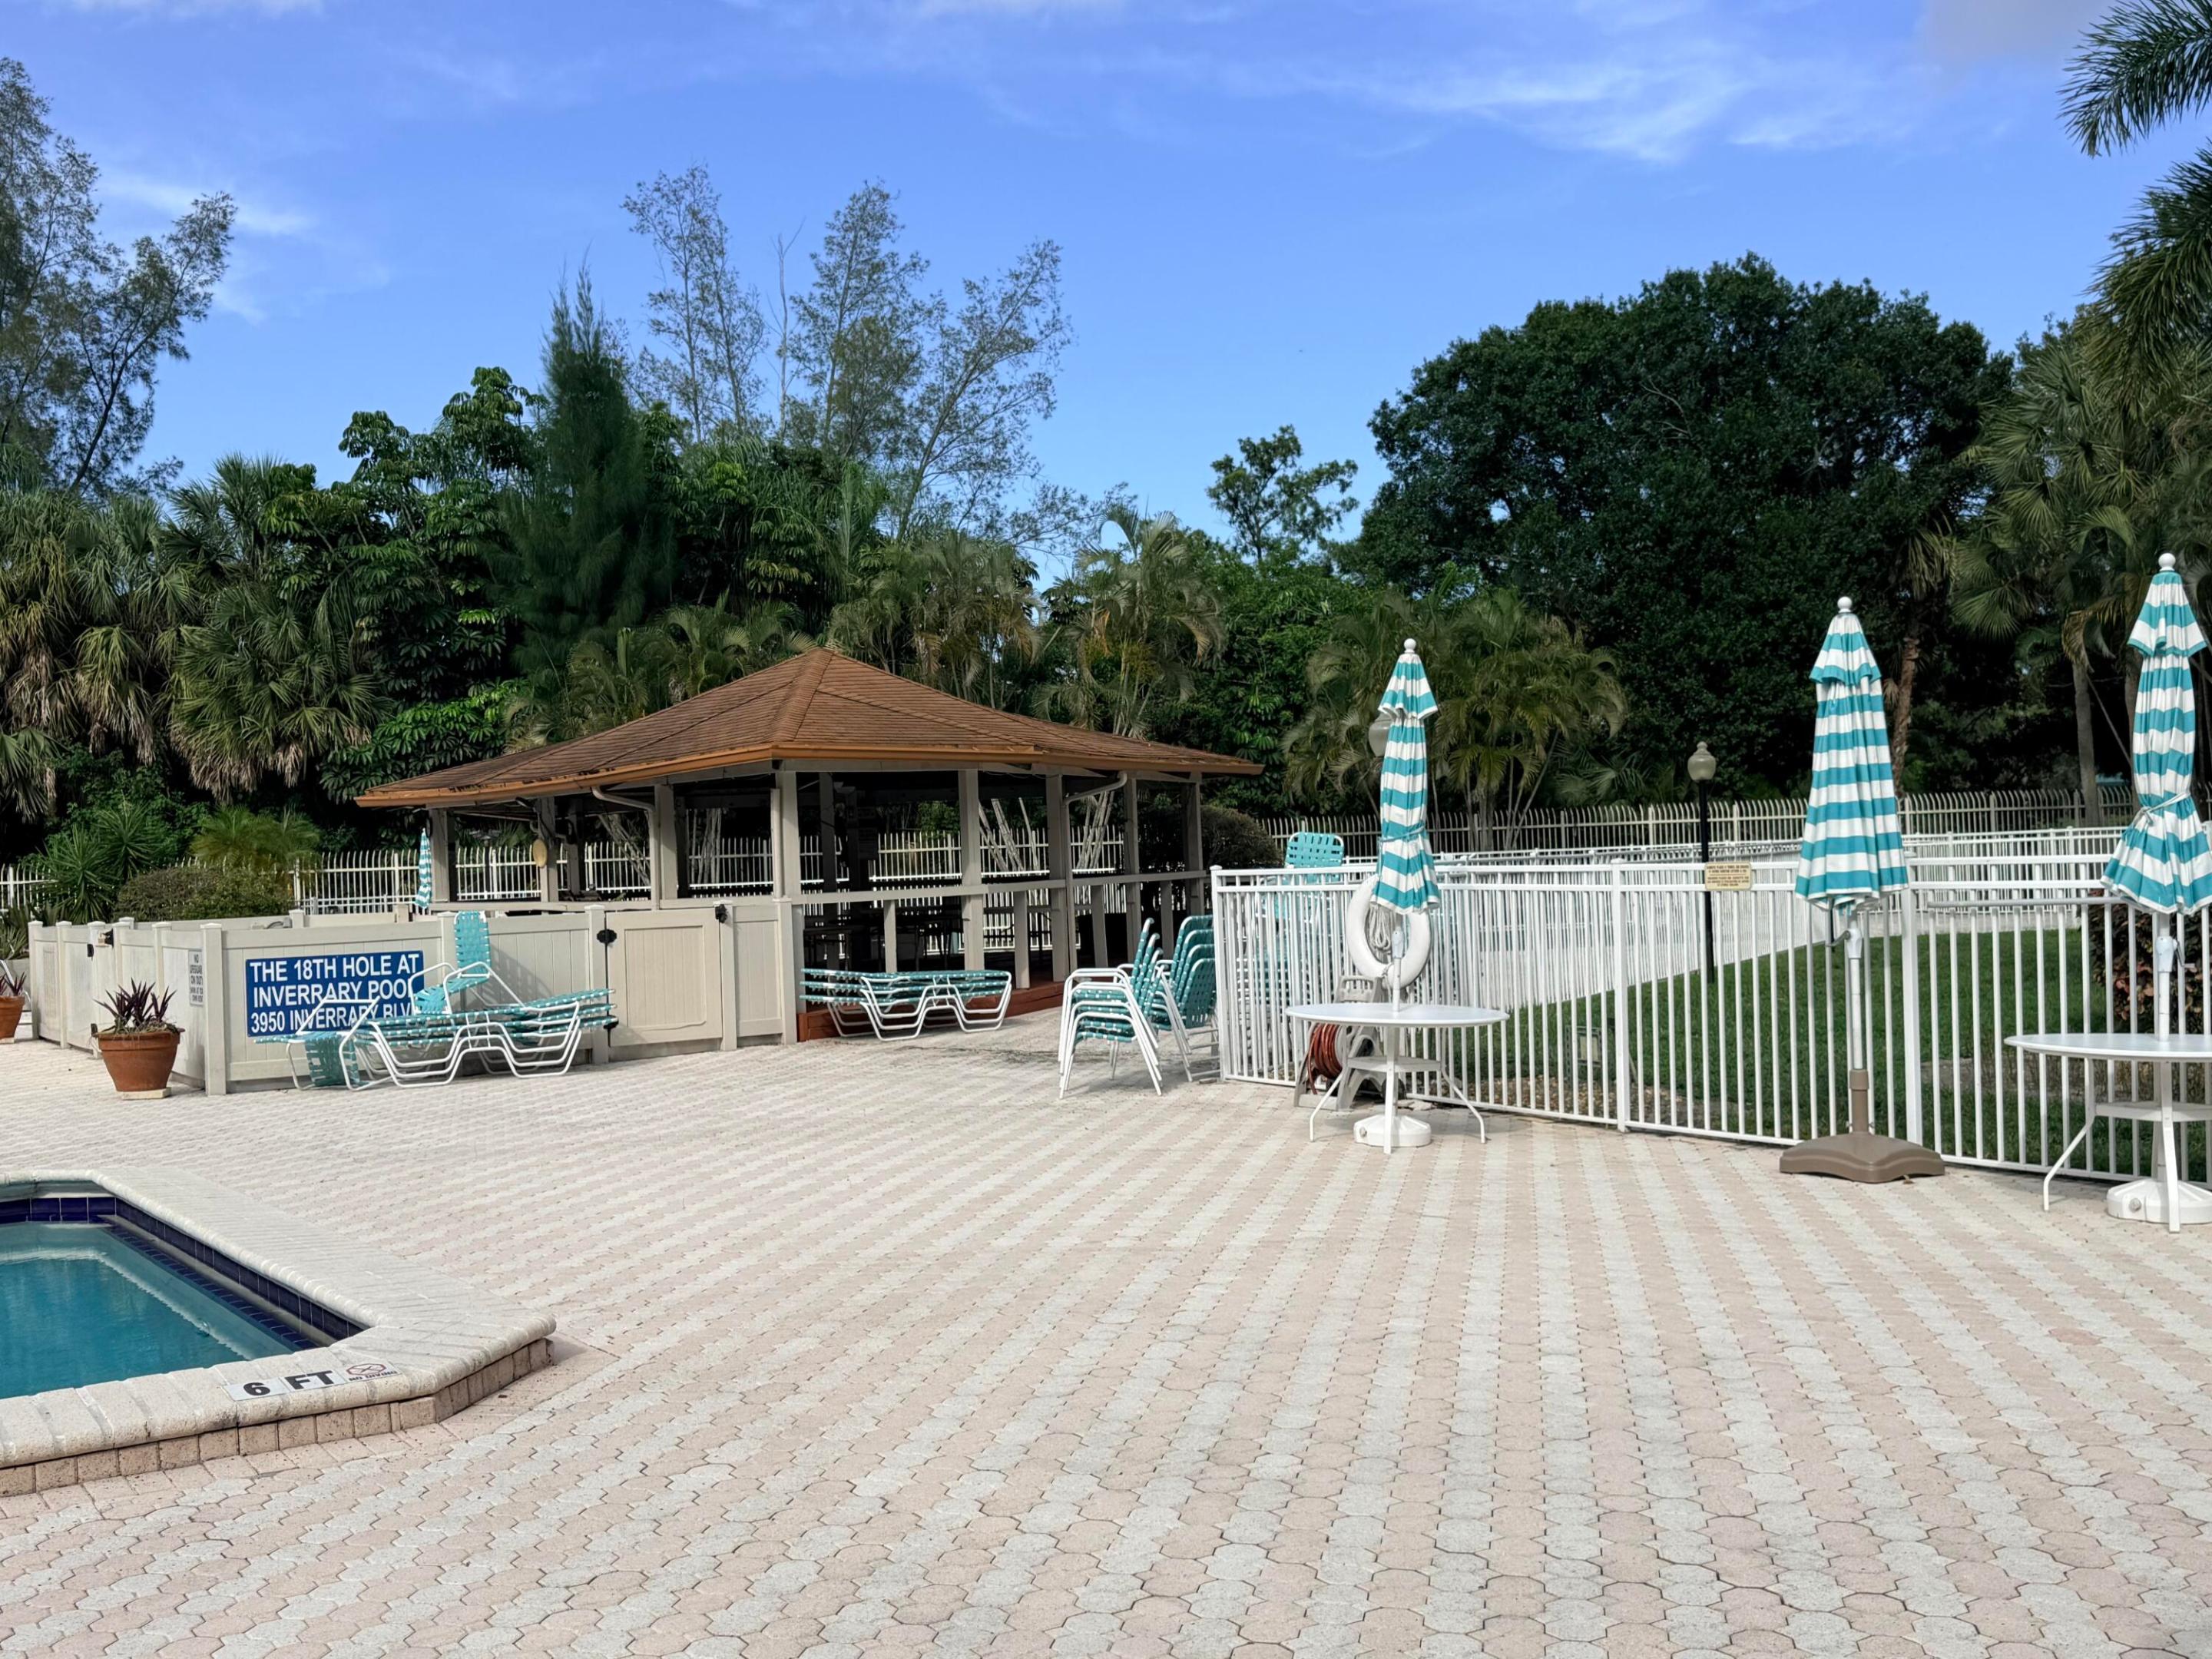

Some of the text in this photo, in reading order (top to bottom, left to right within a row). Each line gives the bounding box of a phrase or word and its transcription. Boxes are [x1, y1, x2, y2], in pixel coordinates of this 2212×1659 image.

[250, 953, 419, 983] THE 18TH HOLE AT
[254, 981, 363, 1008] INVERRARY
[250, 1011, 286, 1033] 3950
[243, 1370, 335, 1396] 6 FT
